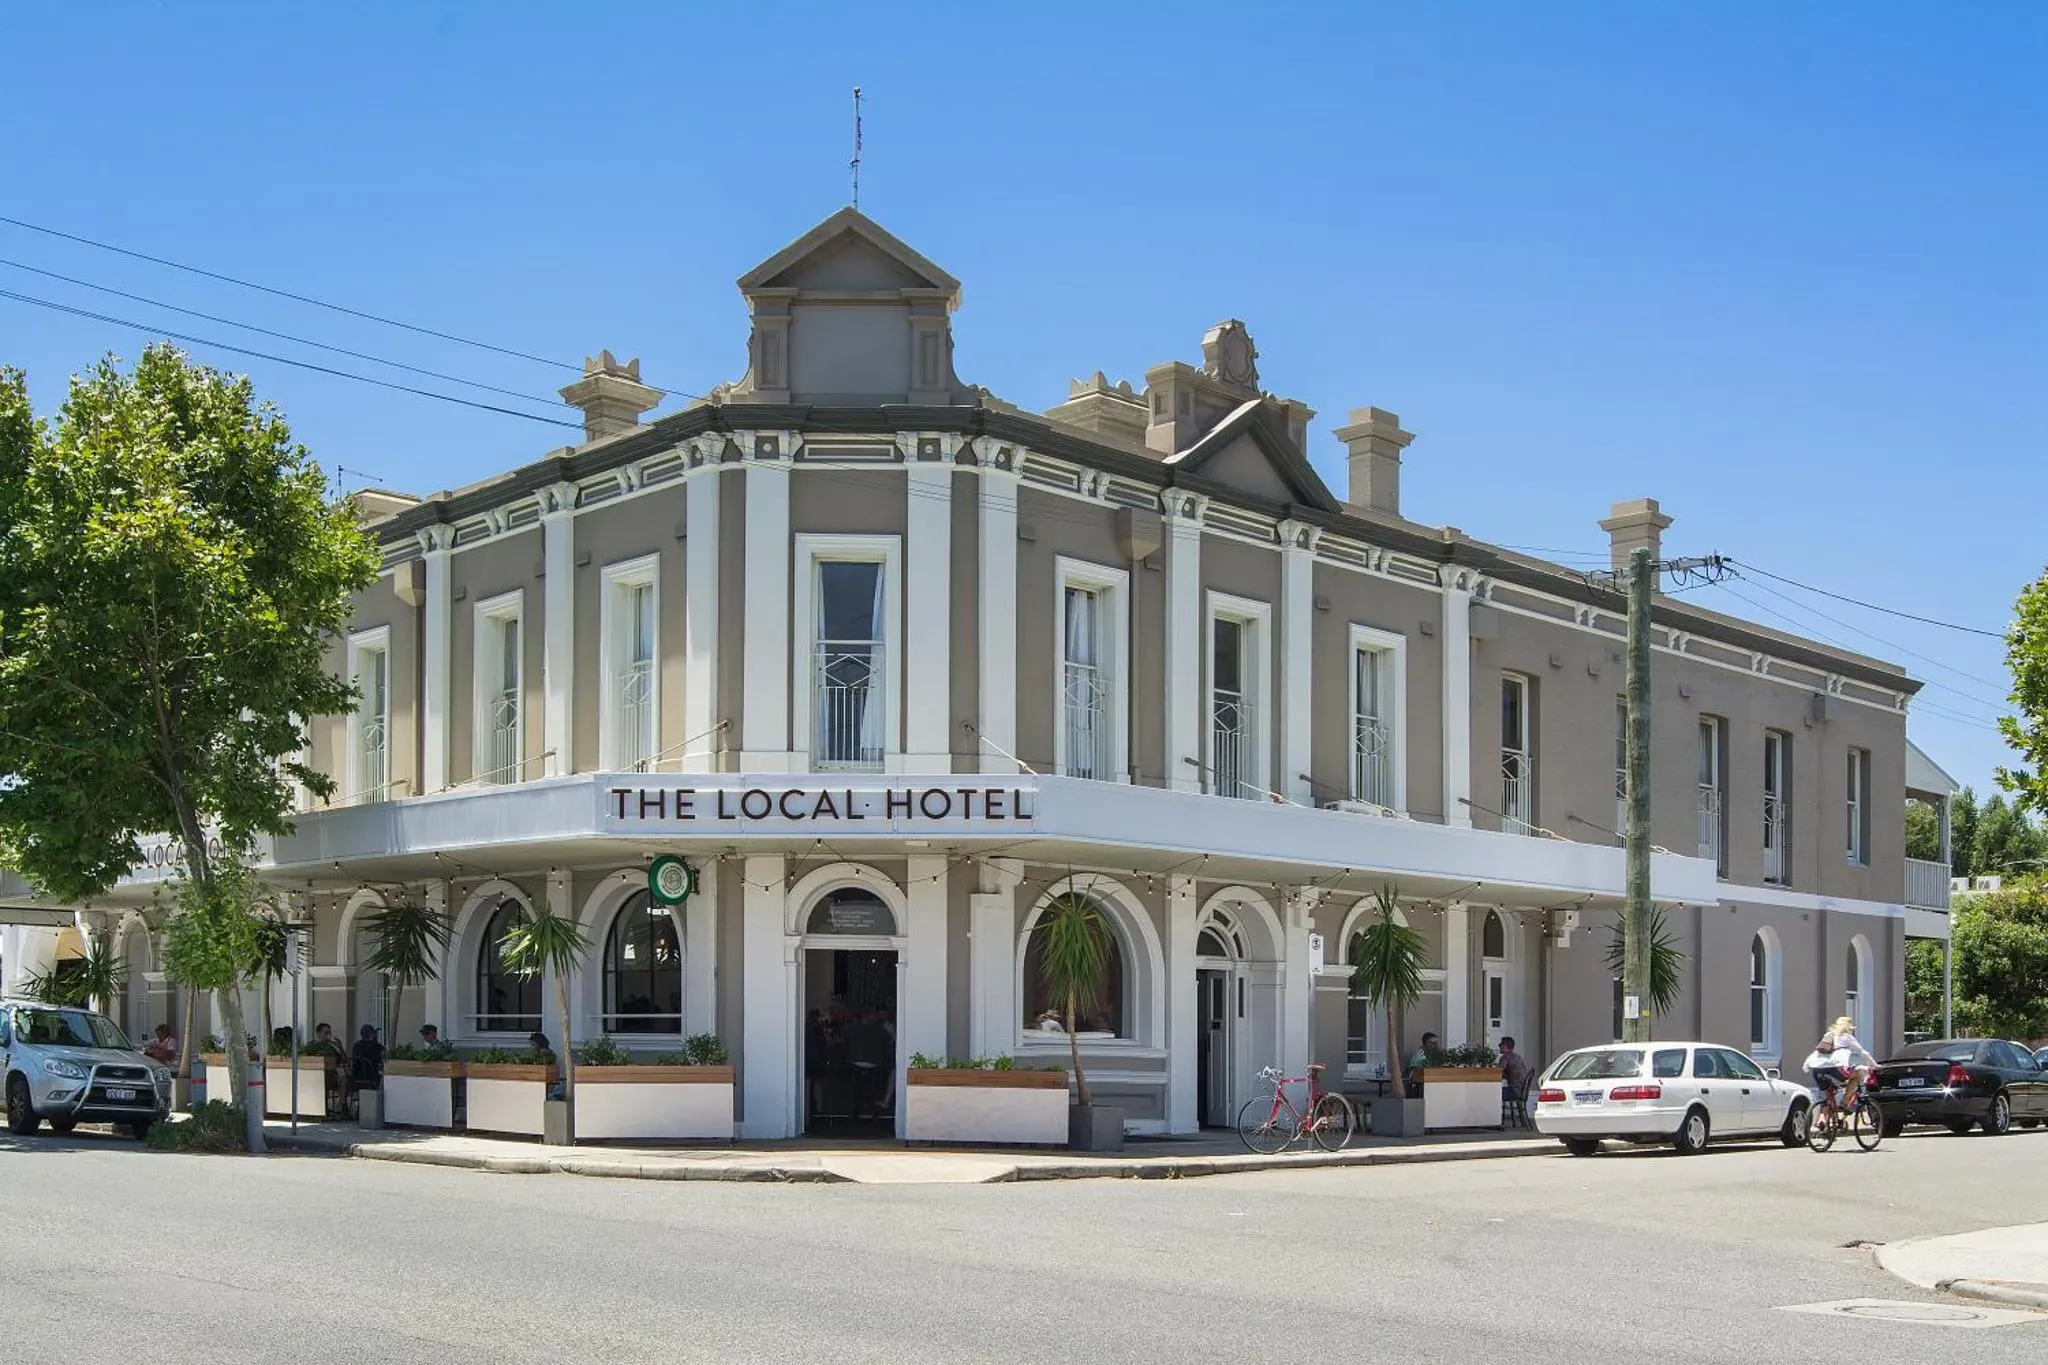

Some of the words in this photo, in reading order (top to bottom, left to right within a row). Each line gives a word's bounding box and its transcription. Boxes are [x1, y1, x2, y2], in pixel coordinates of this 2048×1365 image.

[611, 788, 695, 820] THE
[717, 788, 864, 820] LOCAL
[886, 788, 1032, 820] HOTEL
[146, 841, 185, 869] LOCA
